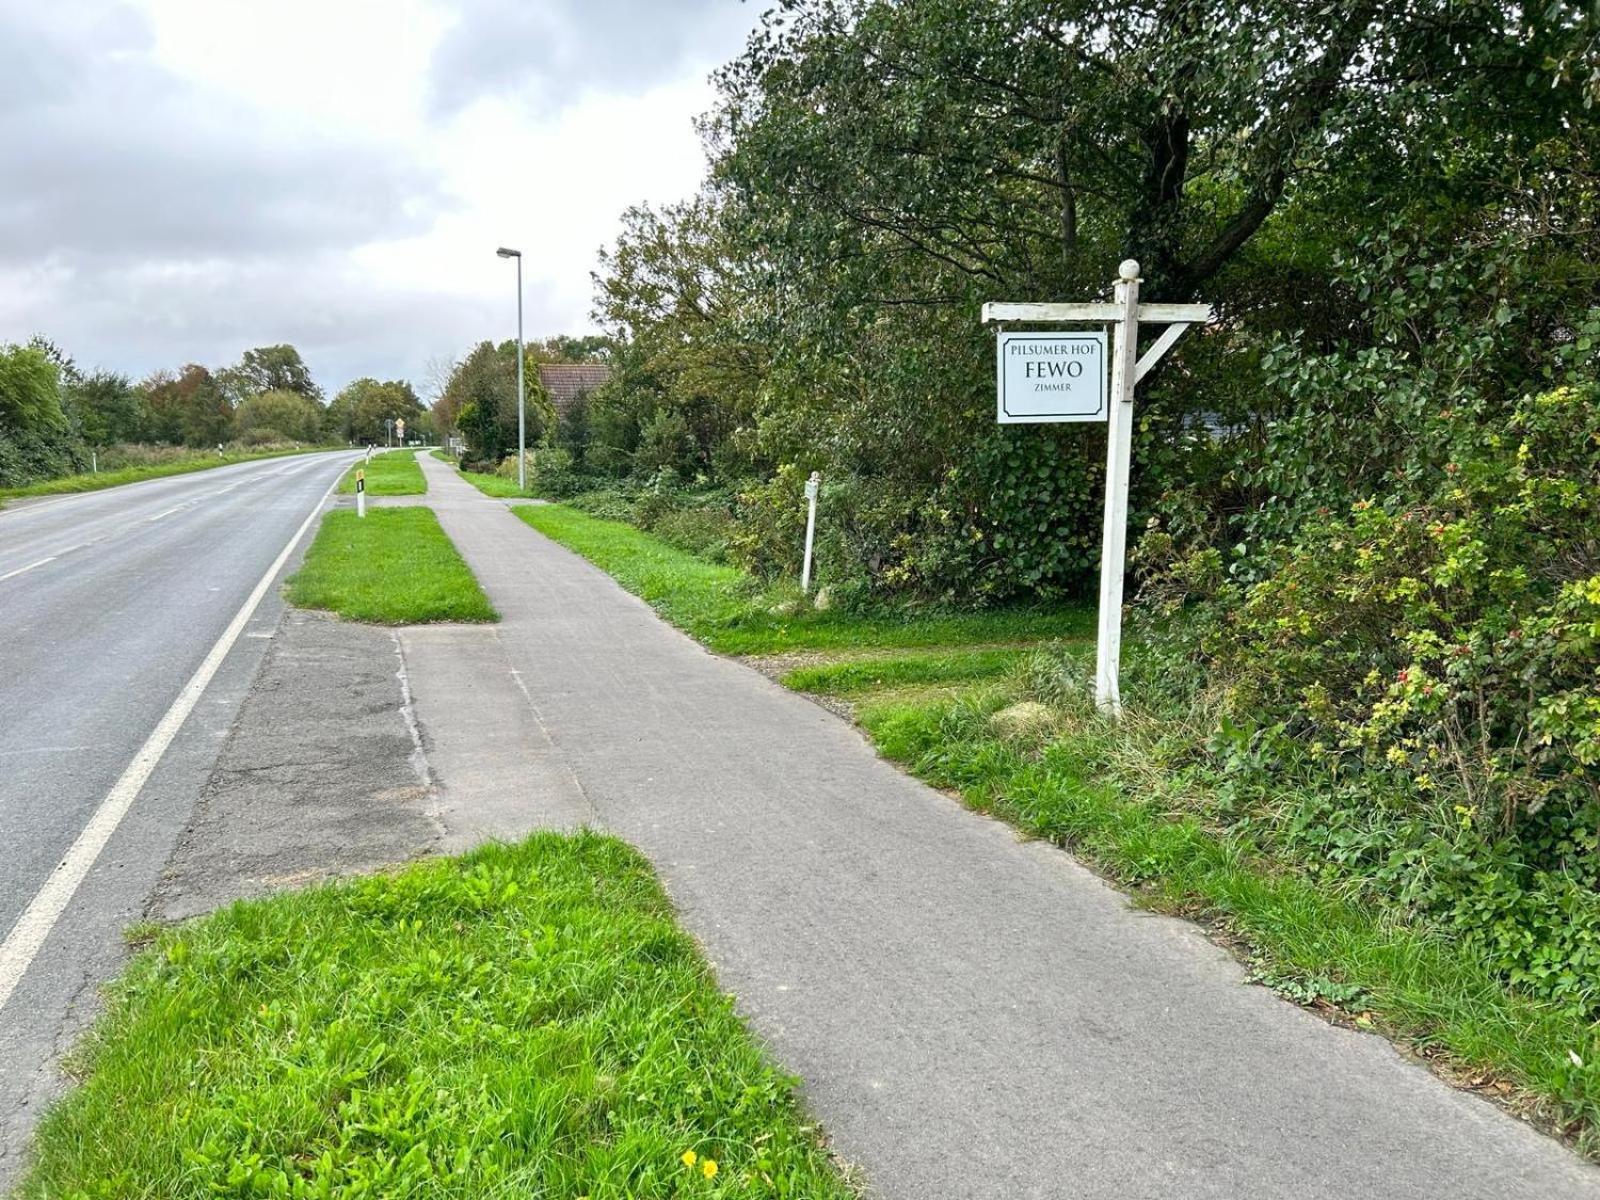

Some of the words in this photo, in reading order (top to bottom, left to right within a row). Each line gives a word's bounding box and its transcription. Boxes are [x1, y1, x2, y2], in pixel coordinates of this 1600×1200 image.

[1011, 345, 1069, 355] PILSUMER
[1071, 344, 1097, 355] HOF
[1025, 361, 1083, 378] FEWO
[1034, 383, 1072, 392] ZIMMER
